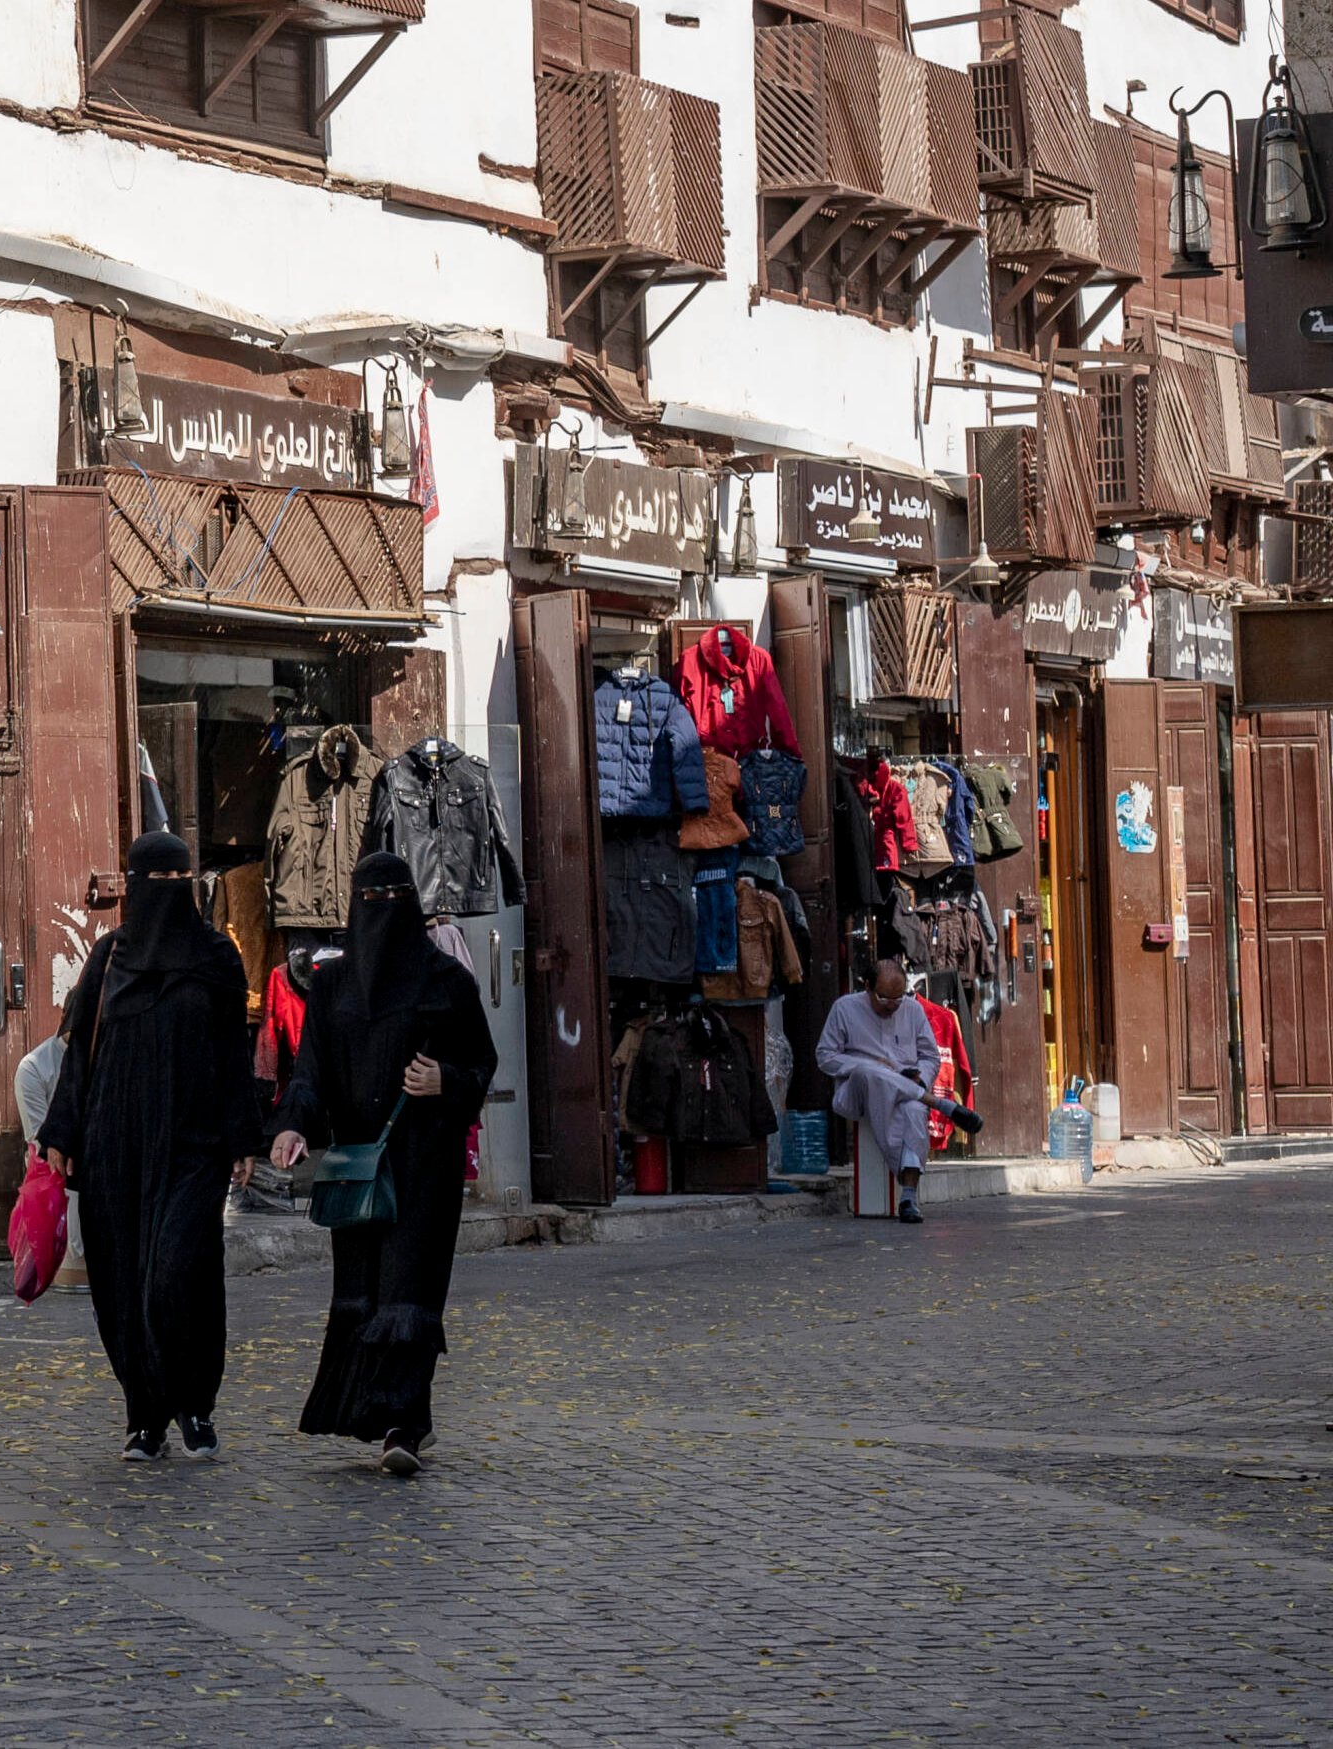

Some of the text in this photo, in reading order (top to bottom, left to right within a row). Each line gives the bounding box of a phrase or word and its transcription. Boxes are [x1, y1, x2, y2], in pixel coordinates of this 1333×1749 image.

[168, 409, 252, 462] للملابس
[257, 421, 319, 482] العلوي
[805, 474, 855, 512] ناصر
[889, 487, 931, 520] محمد
[610, 485, 666, 550] العلوي
[874, 532, 924, 550] للملابس
[1025, 596, 1066, 623] للعطور
